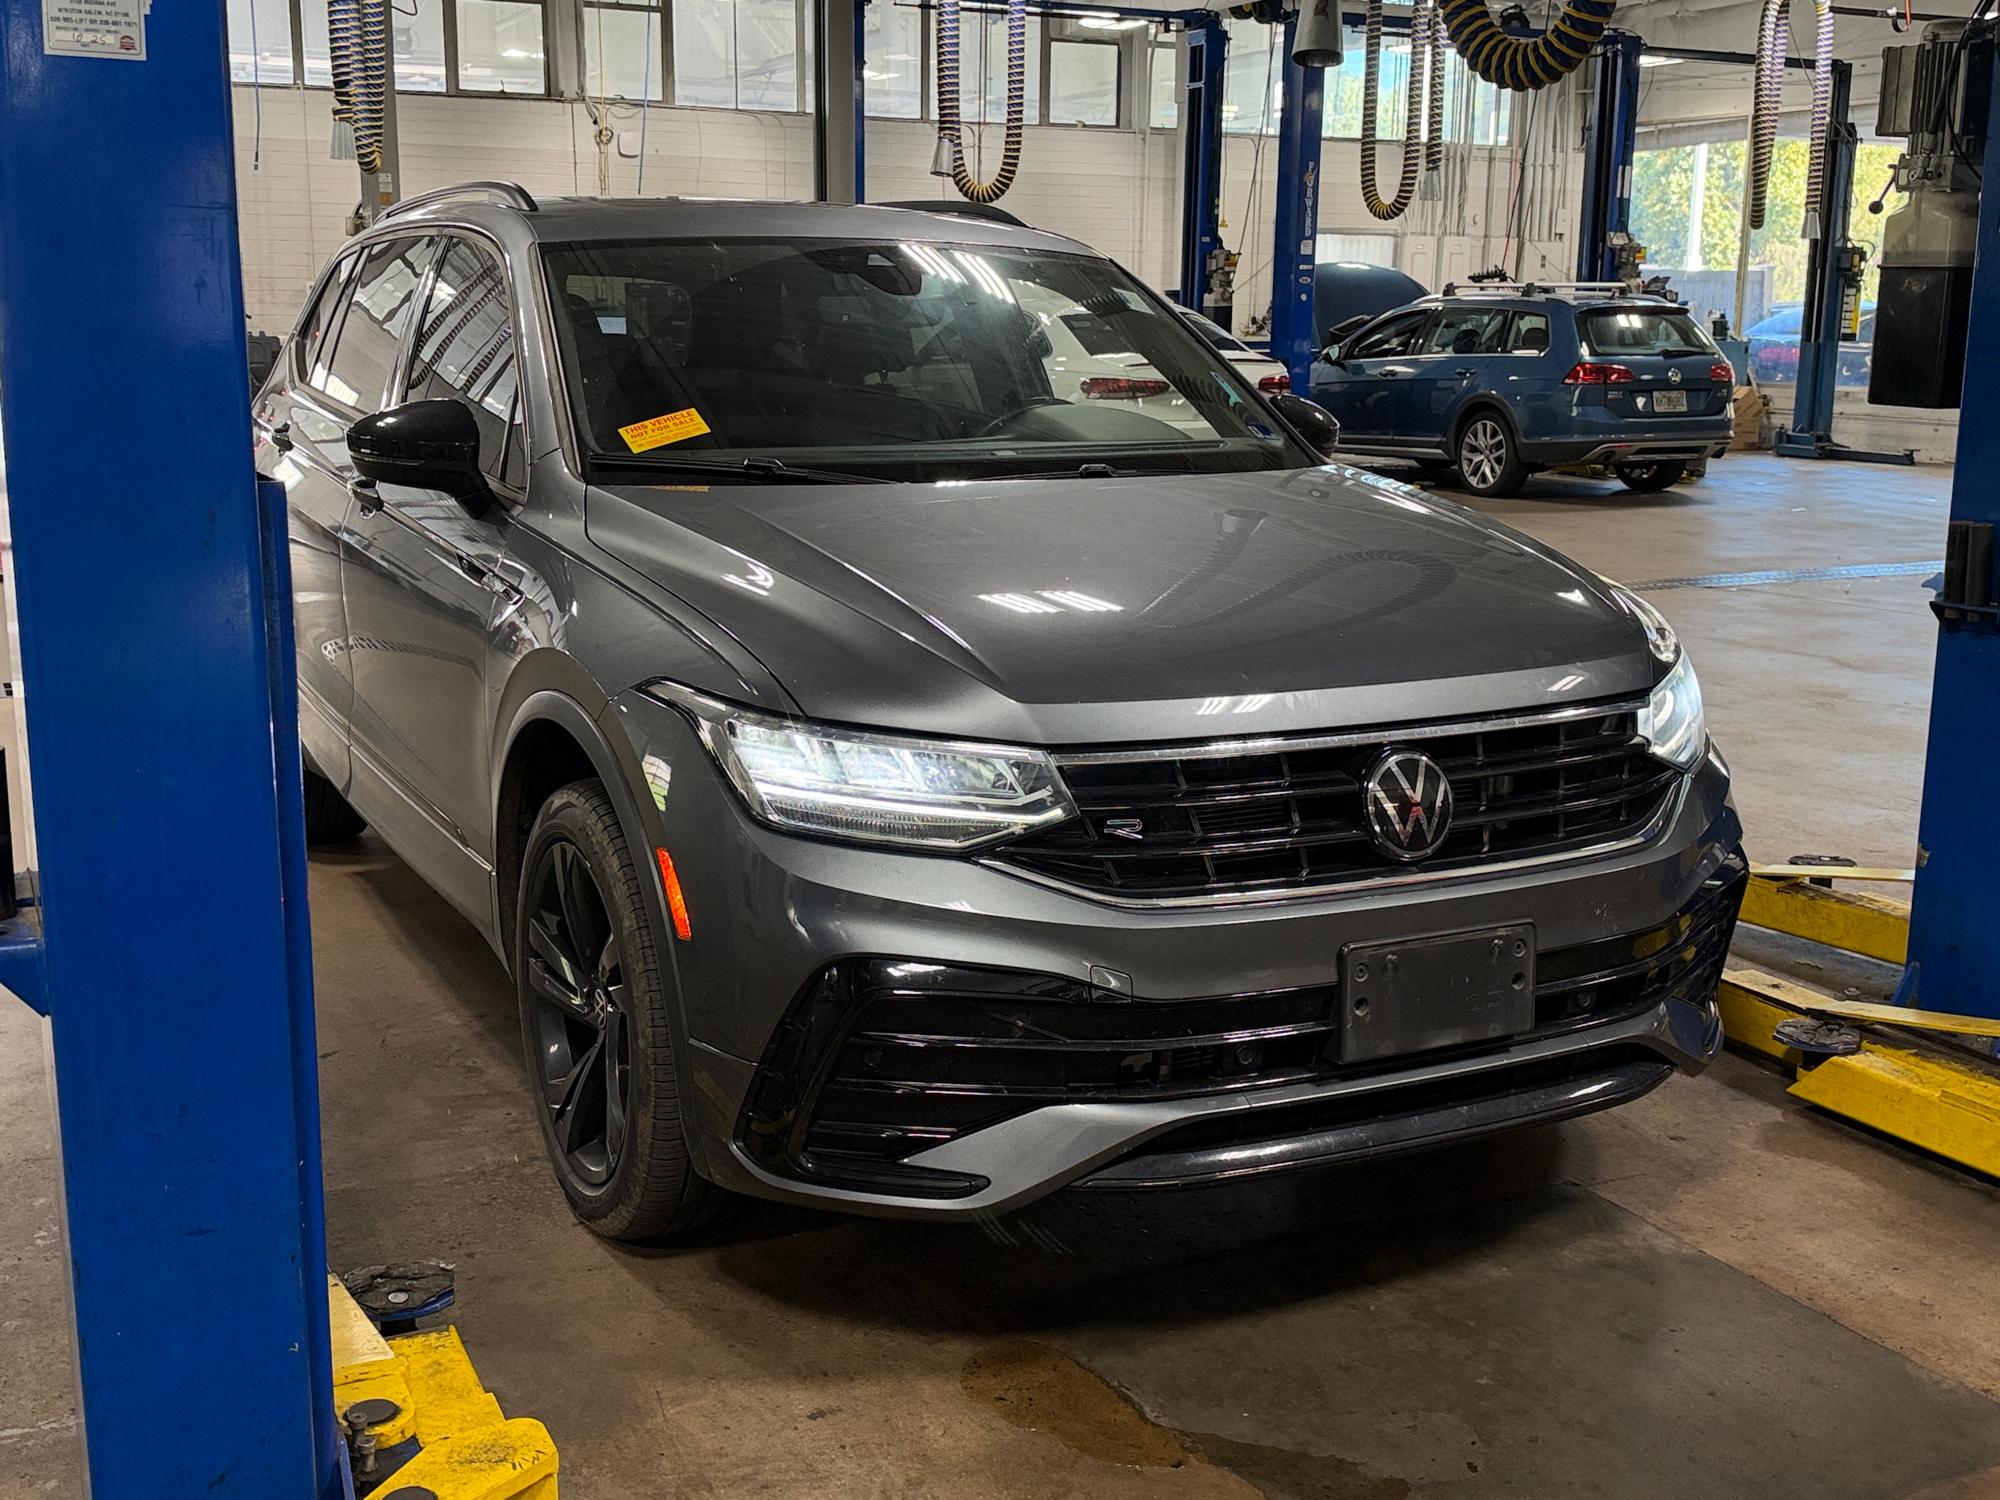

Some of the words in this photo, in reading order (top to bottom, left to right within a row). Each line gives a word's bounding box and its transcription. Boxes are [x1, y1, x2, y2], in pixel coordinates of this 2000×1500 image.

[623, 423, 649, 435] THIS
[648, 410, 694, 426] VEHICLE
[630, 430, 649, 439] NOT
[651, 424, 671, 434] FOR
[672, 417, 696, 427] SALE
[1103, 818, 1143, 839] R
